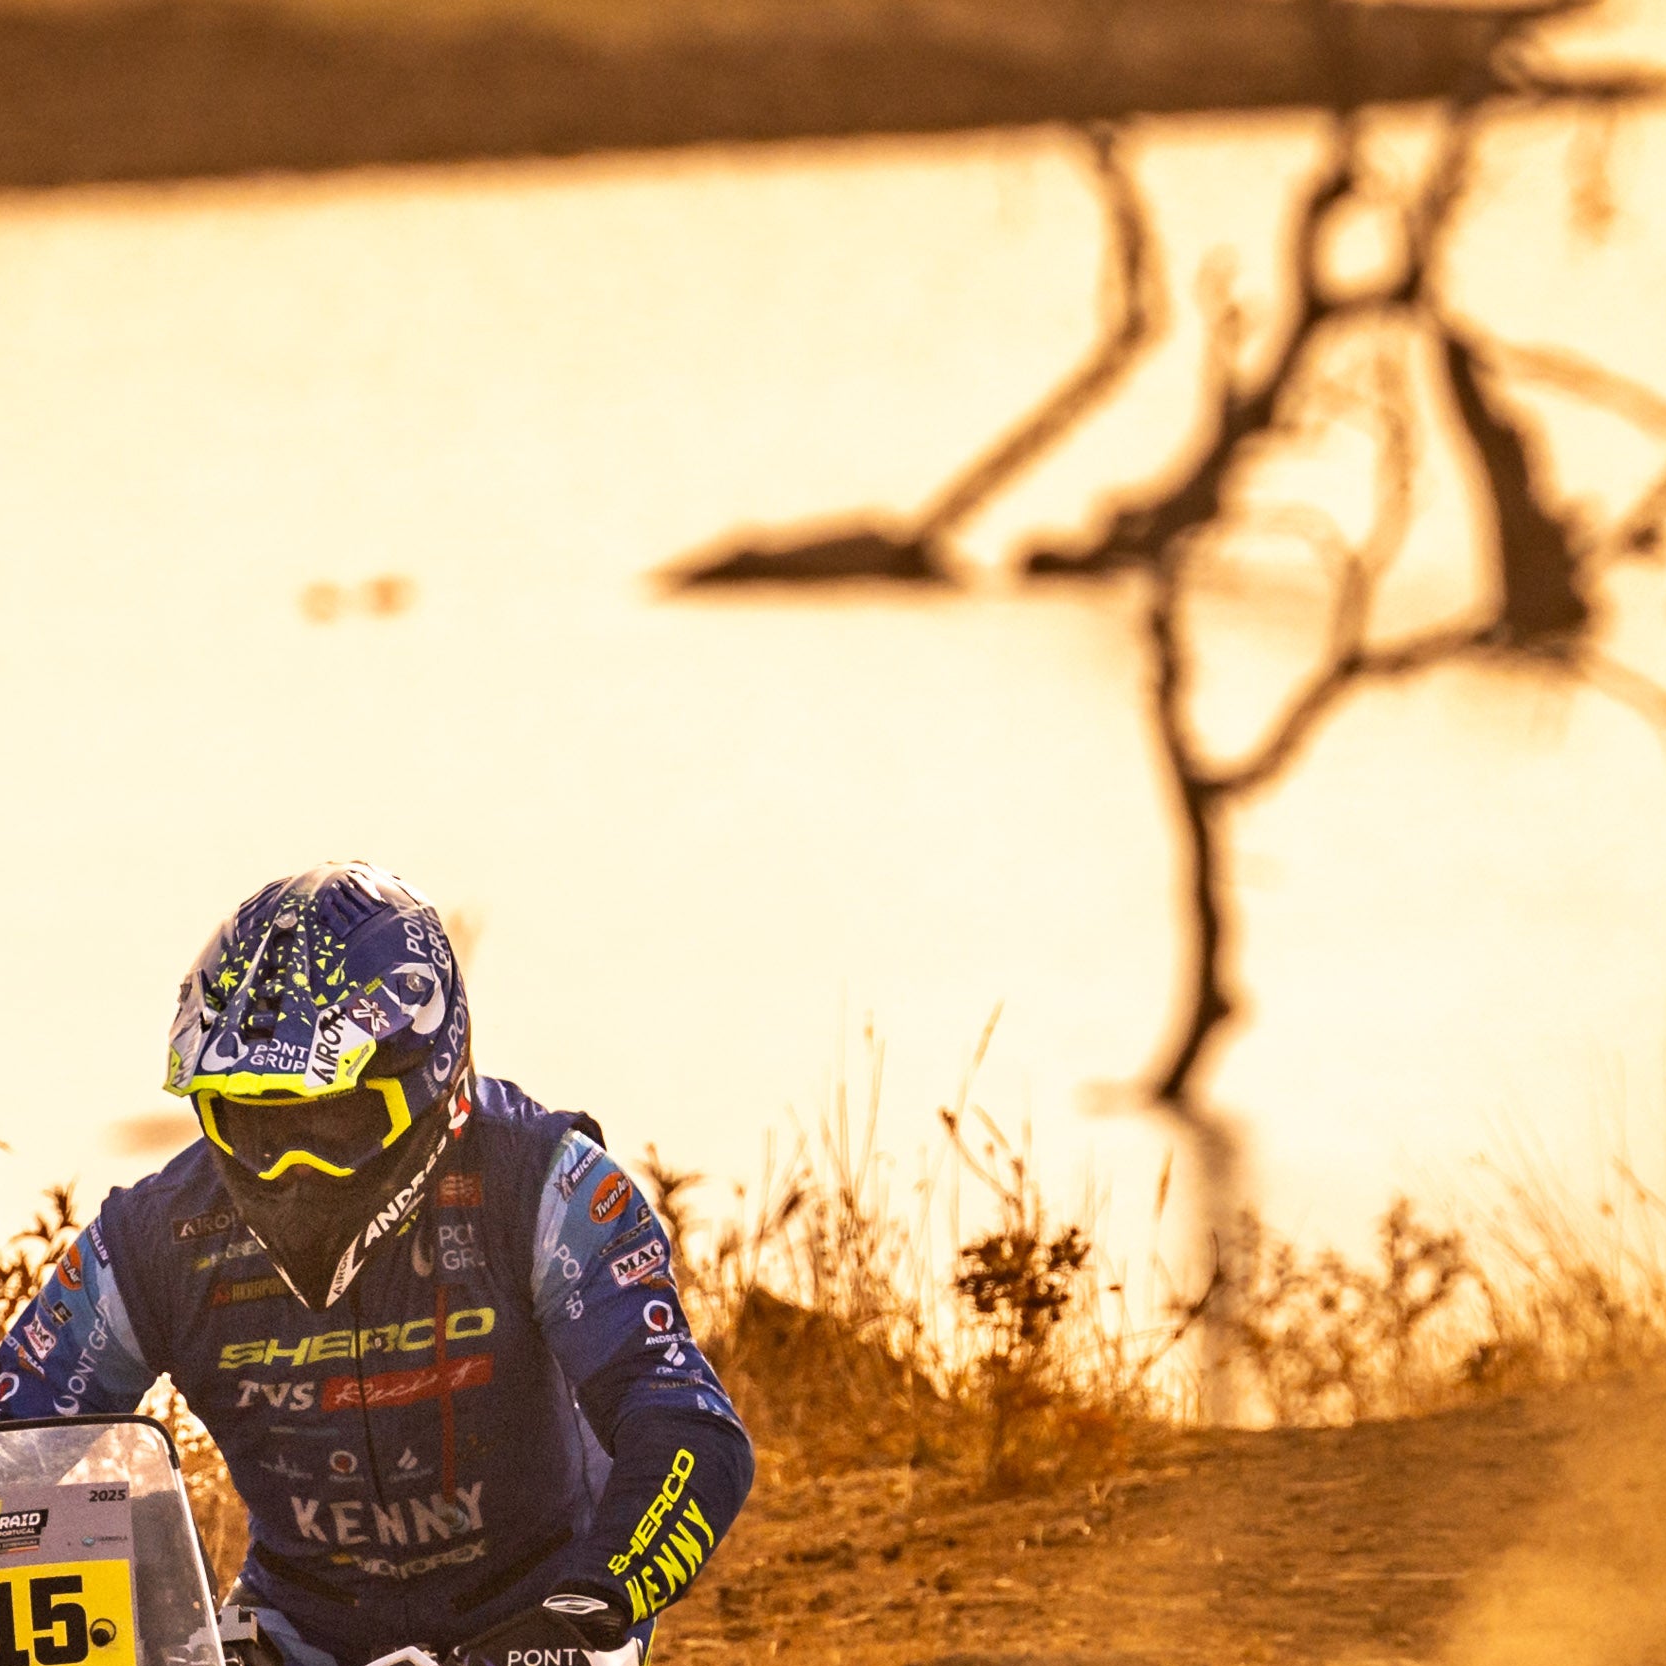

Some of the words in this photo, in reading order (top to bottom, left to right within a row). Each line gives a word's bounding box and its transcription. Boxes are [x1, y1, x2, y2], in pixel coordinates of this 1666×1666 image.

[249, 1053, 306, 1073] GRUP
[254, 1038, 309, 1060] PONT
[614, 1240, 664, 1277] MAC
[218, 1307, 496, 1370] SHERCO
[235, 1379, 315, 1411] TVS
[88, 1488, 127, 1503] 2025
[607, 1448, 695, 1577] SHERCO
[0, 1512, 41, 1530] RAID
[290, 1480, 484, 1546] KENNY
[625, 1498, 715, 1624] KENNY
